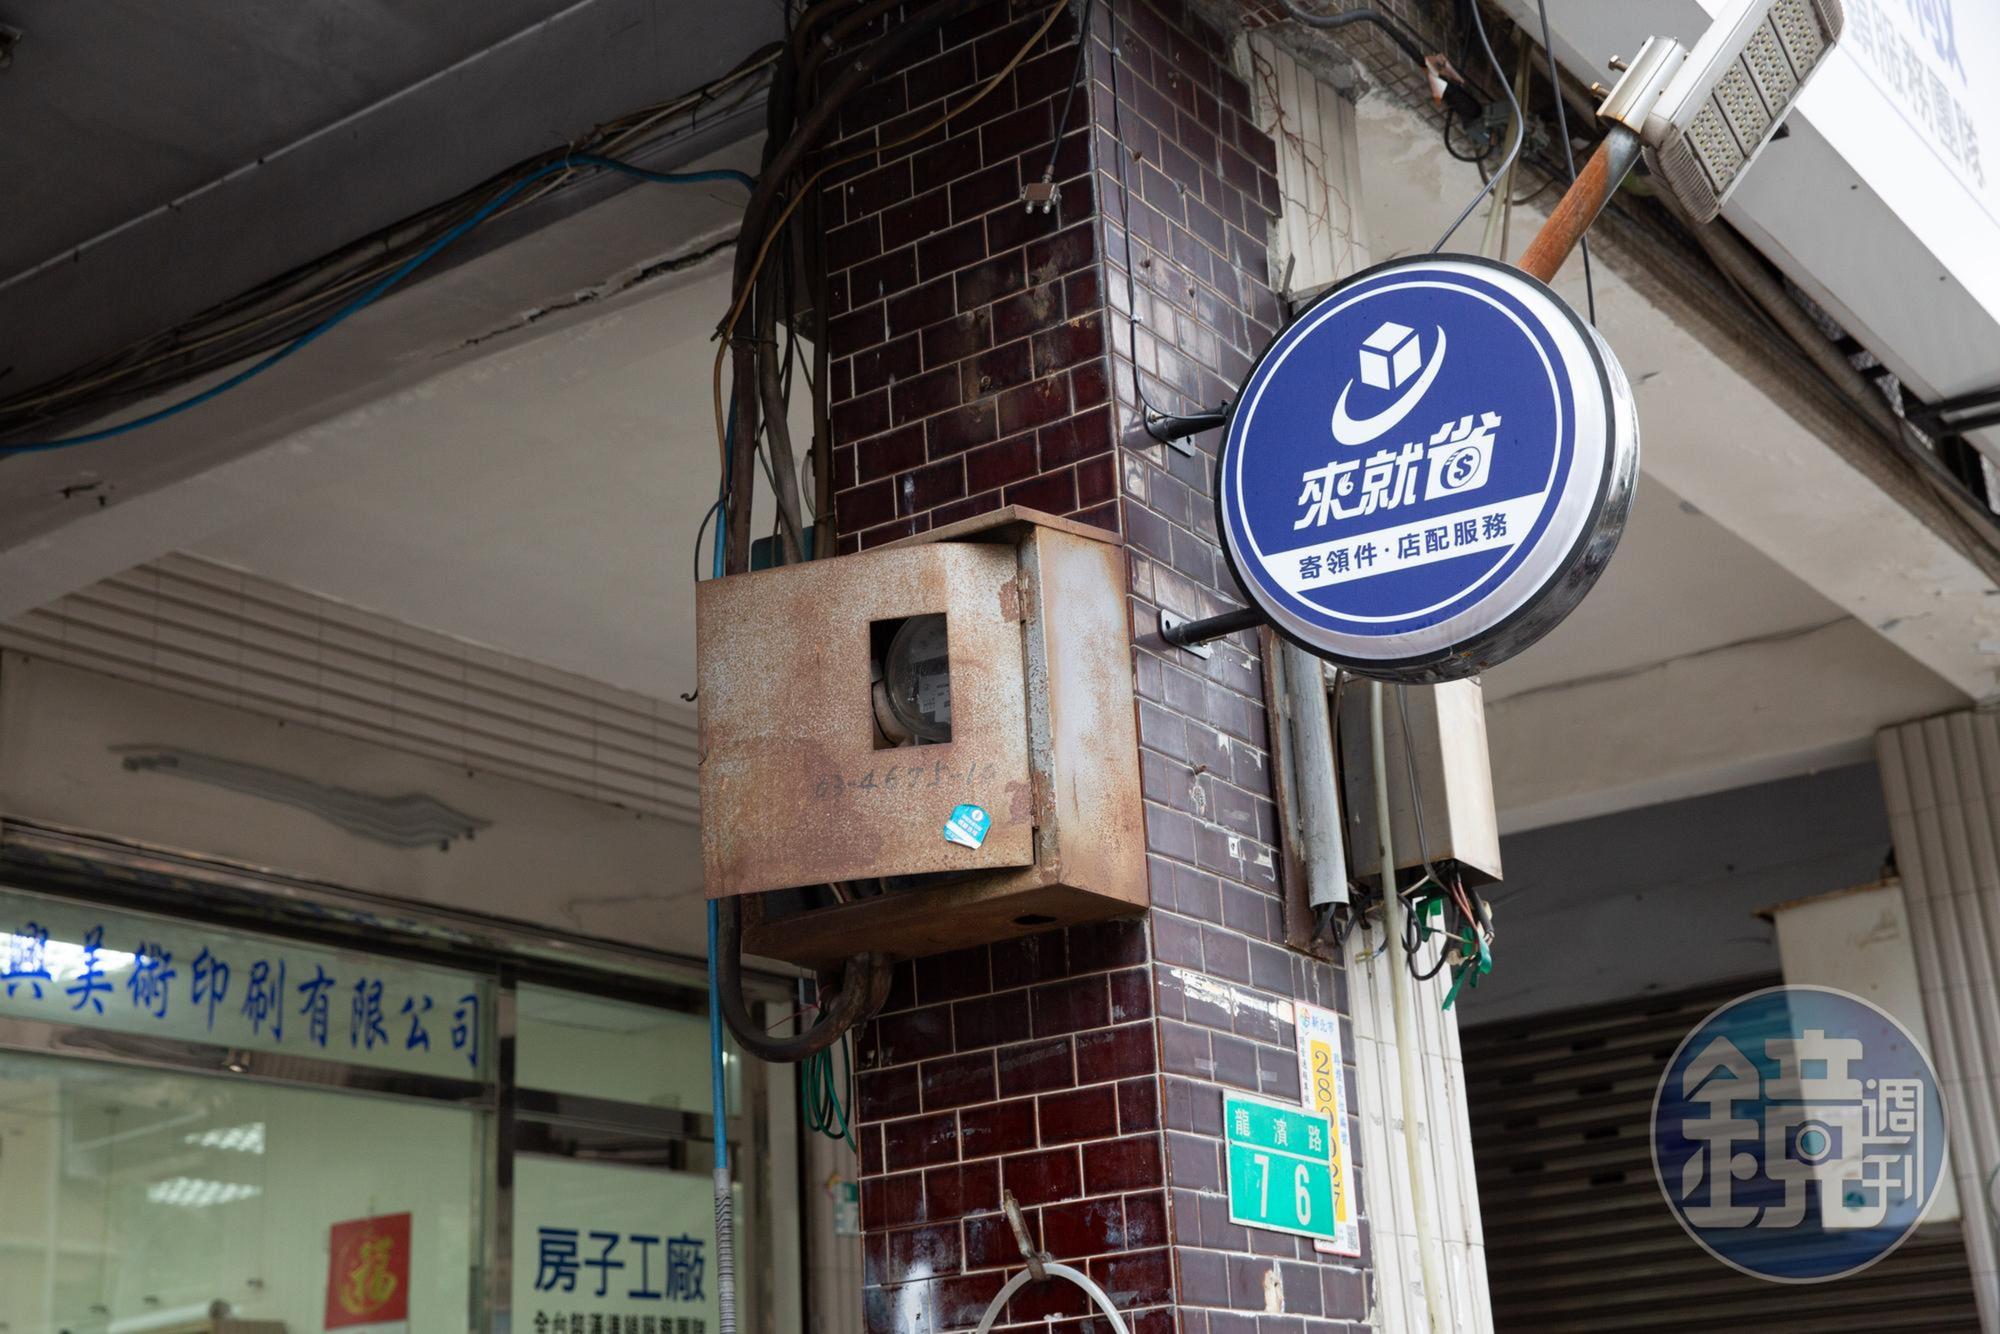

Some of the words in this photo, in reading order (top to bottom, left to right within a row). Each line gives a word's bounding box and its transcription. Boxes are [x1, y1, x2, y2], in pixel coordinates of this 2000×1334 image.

[1293, 411, 1503, 531] 來就省
[0, 922, 480, 1068] 興美術印刷有限公司
[1234, 1108, 1322, 1153] 龍濱路
[1253, 1154, 1312, 1226] 76
[534, 1226, 706, 1303] 房子工廠
